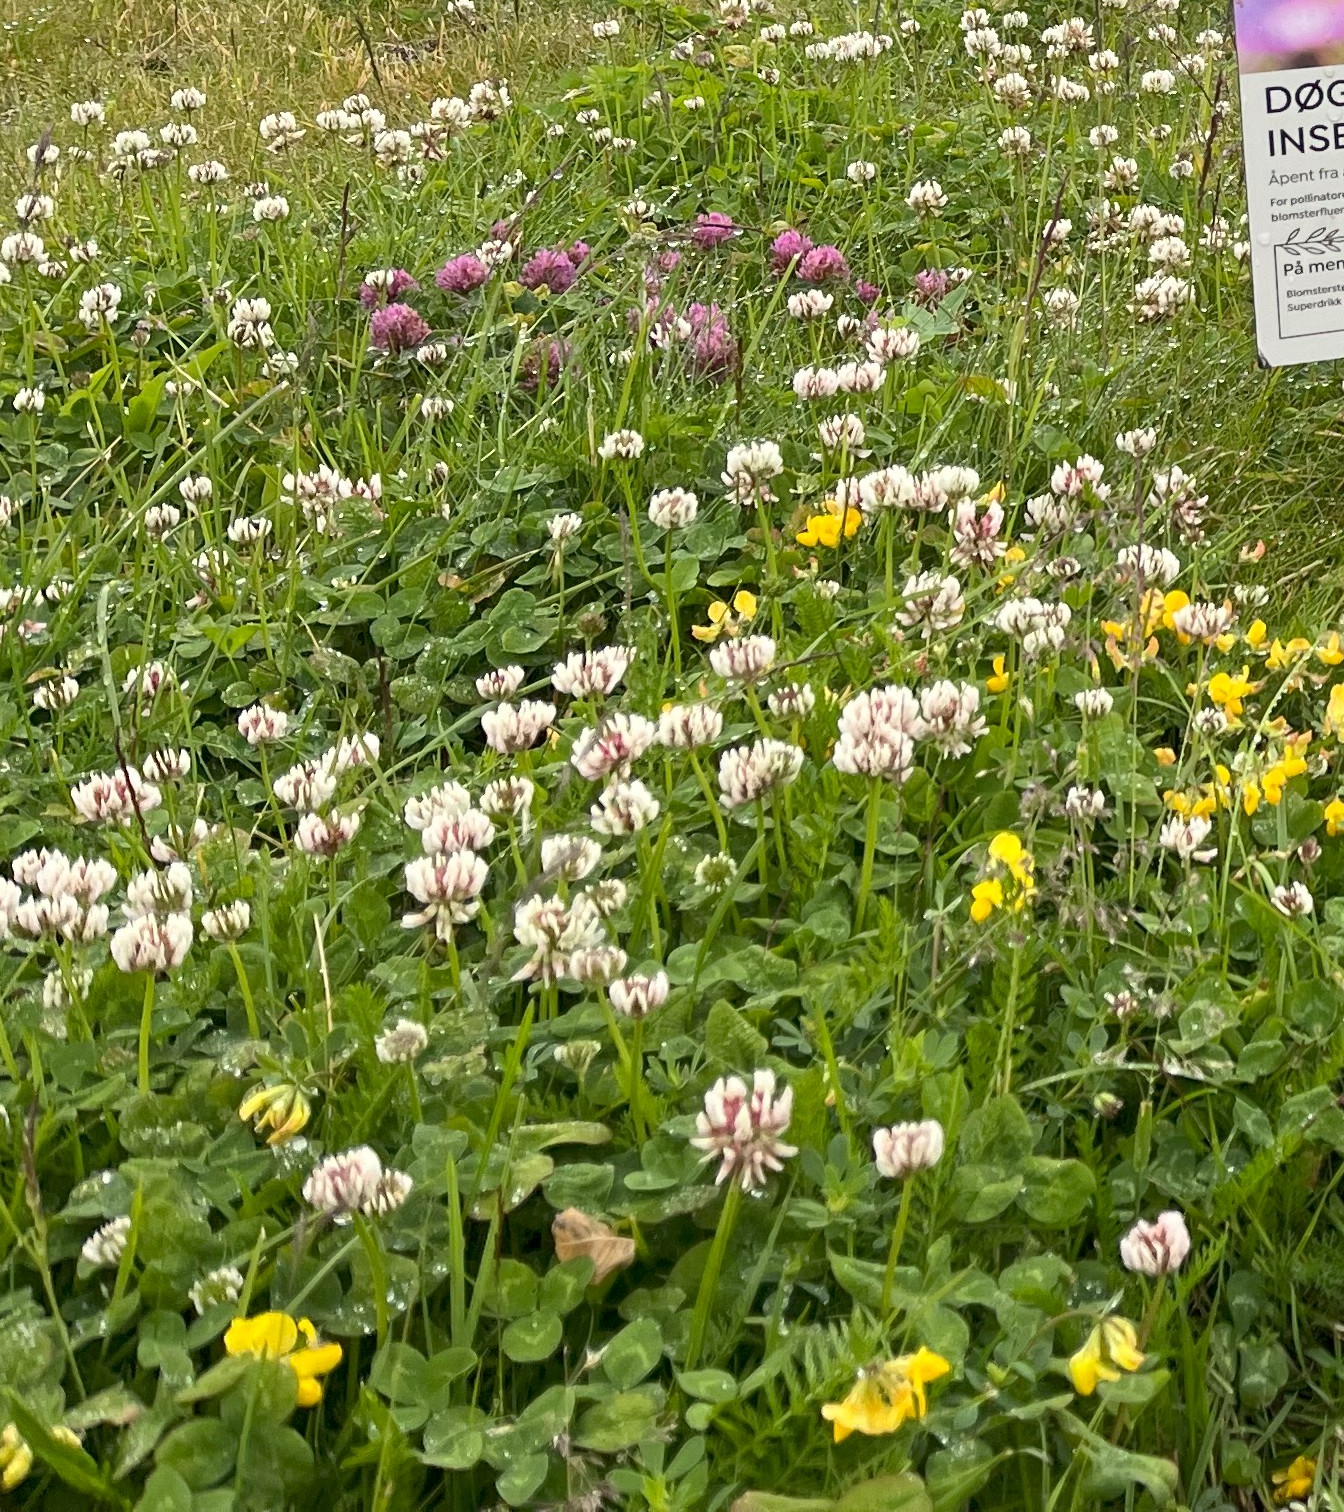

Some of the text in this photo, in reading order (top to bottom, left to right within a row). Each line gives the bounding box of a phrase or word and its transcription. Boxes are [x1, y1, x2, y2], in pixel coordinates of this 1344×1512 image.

[1268, 170, 1314, 186] Åpent
[1319, 168, 1338, 180] fra
[1270, 198, 1287, 207] For
[1283, 260, 1304, 276] På
[1287, 297, 1342, 312] Superdrikk
